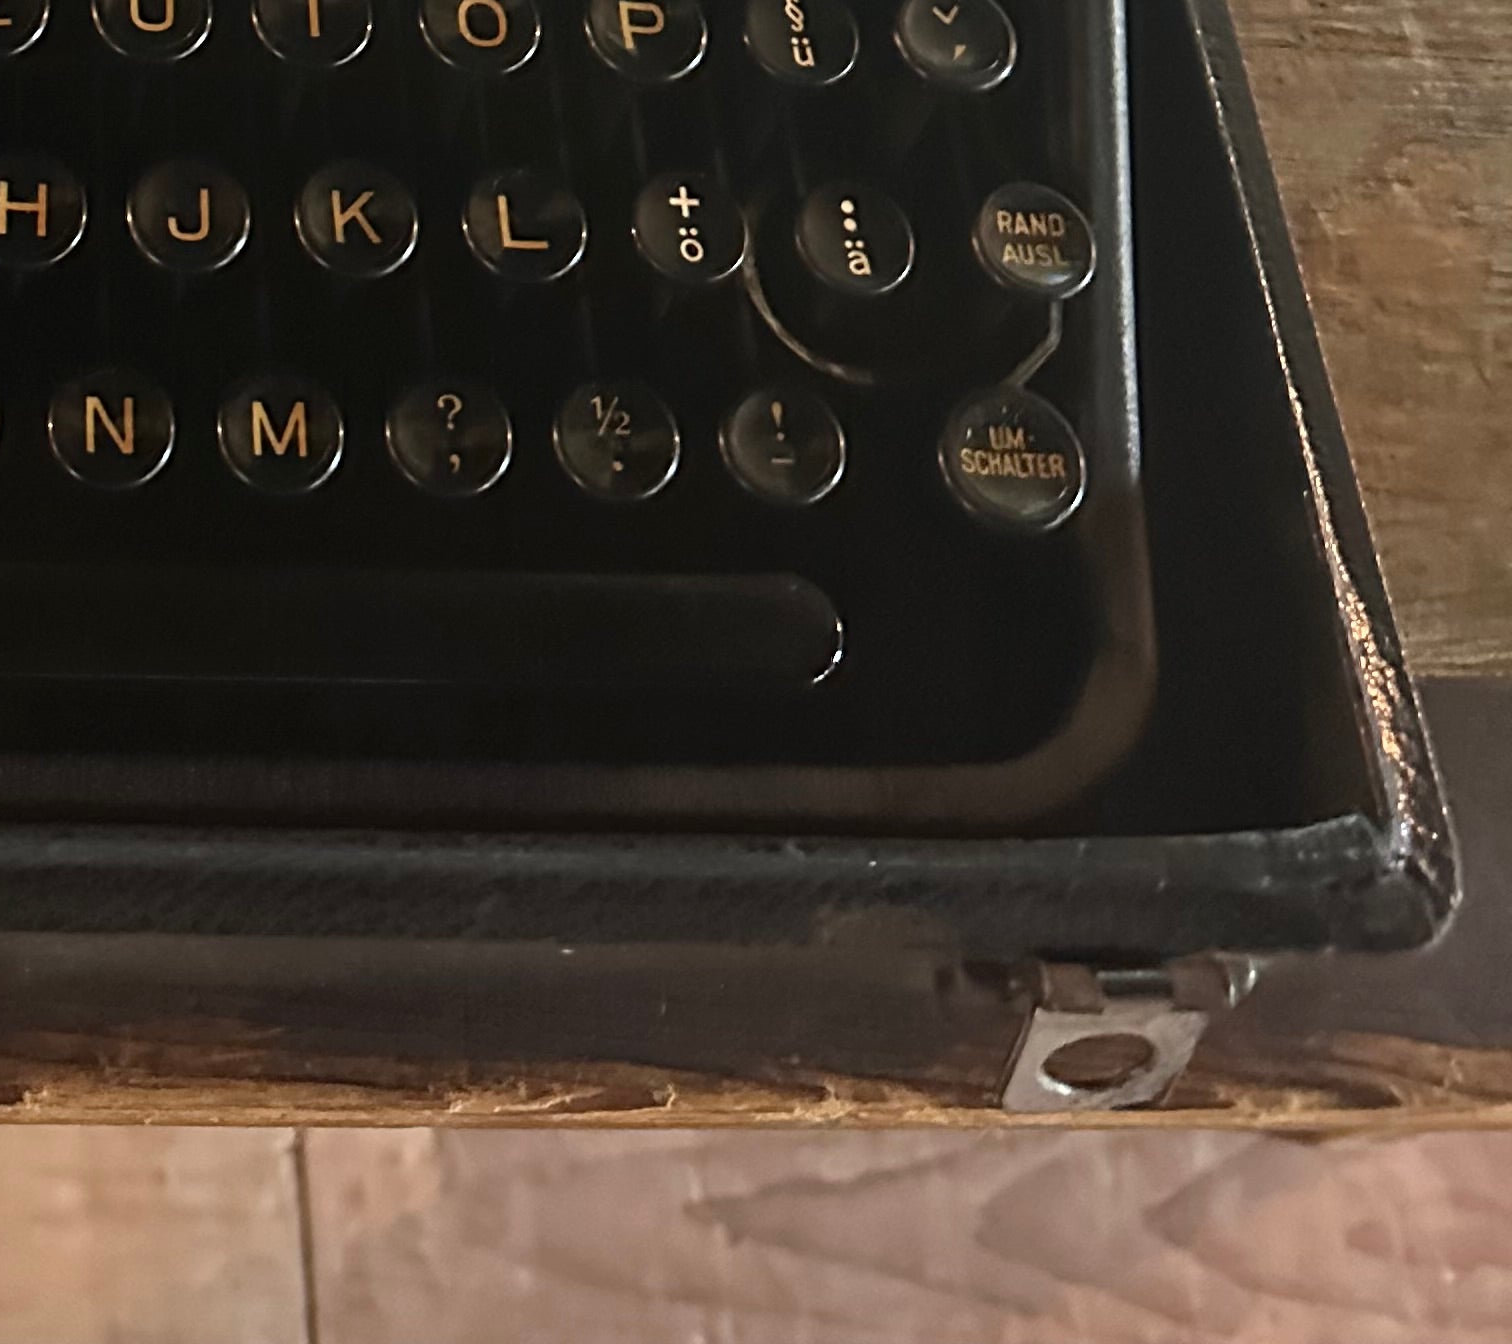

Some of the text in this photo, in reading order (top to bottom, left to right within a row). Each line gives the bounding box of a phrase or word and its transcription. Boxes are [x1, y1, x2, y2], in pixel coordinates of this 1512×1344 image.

[619, 1, 663, 52] P
[168, 190, 209, 240] J
[332, 191, 380, 242] K
[498, 196, 548, 248] L
[669, 187, 699, 217] +
[86, 397, 133, 453] N
[253, 402, 306, 456] M
[438, 395, 461, 429] ?
[772, 402, 784, 440] !
[960, 447, 1066, 479] SCHALTER
